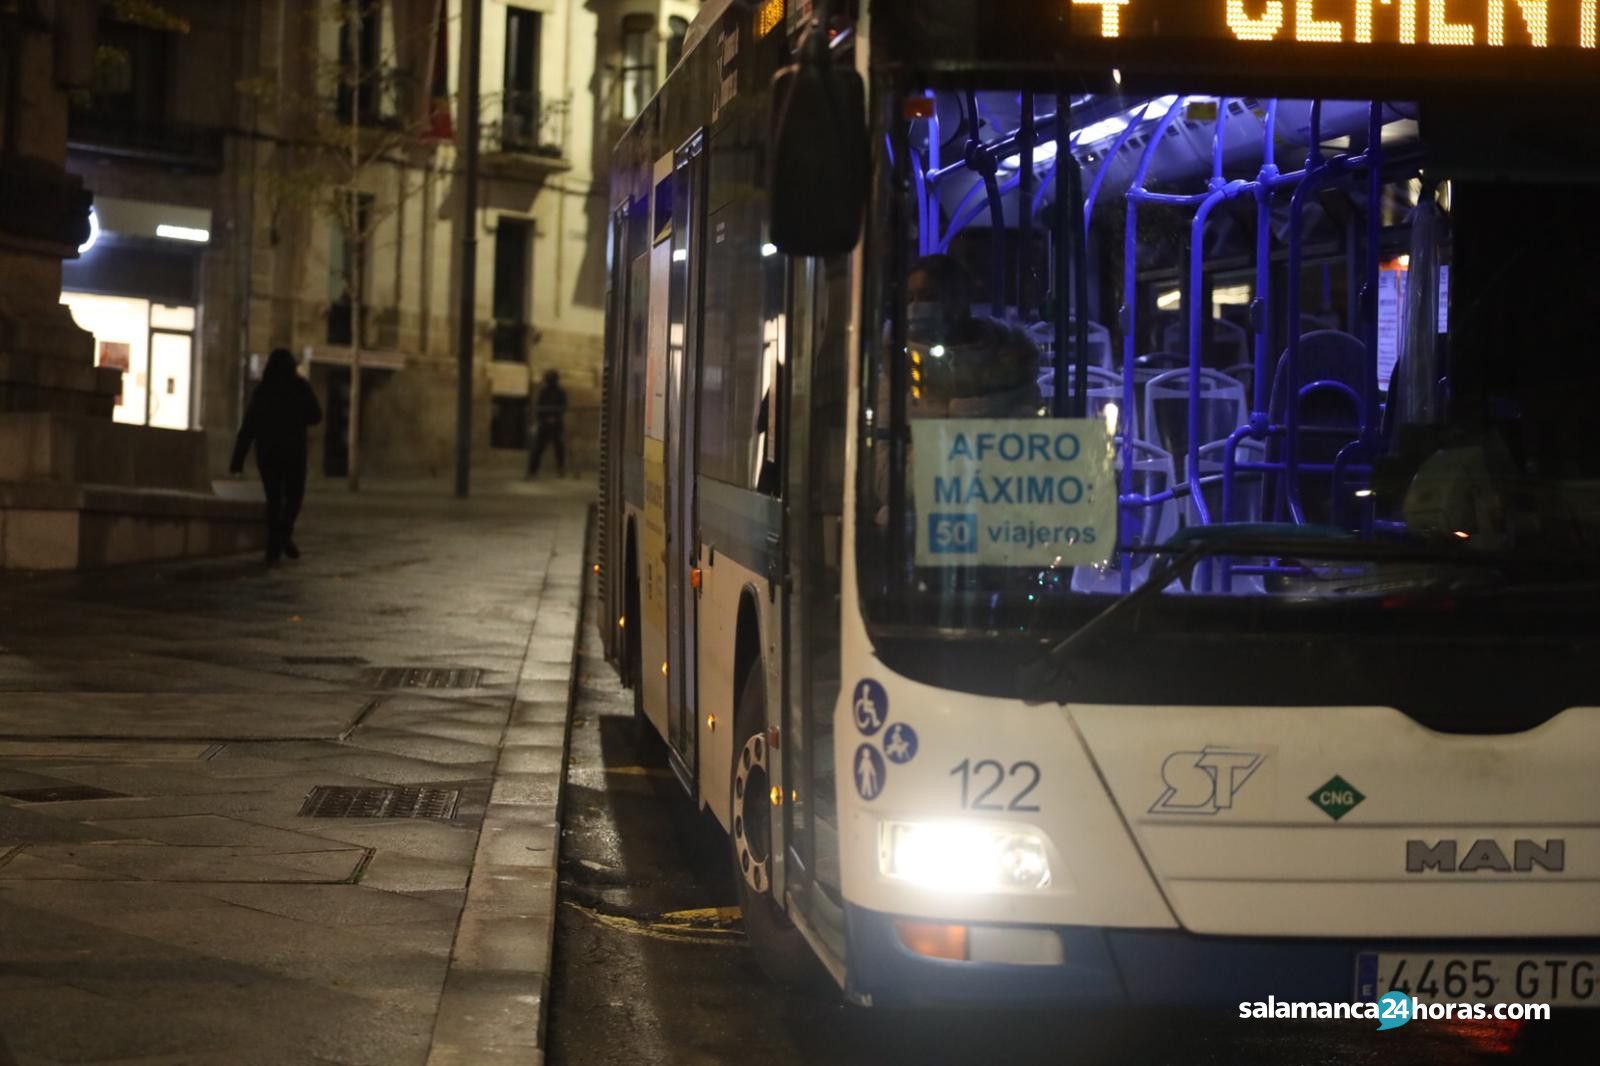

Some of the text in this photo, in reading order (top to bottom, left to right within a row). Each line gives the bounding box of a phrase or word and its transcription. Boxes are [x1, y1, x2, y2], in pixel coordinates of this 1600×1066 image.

[948, 433, 1080, 462] AFORO
[936, 520, 1096, 548] 50 viajeros
[950, 757, 1041, 812] 122
[1320, 790, 1354, 806] CNG
[1405, 839, 1565, 873] MAN
[1388, 959, 1594, 999] 4465 GTG
